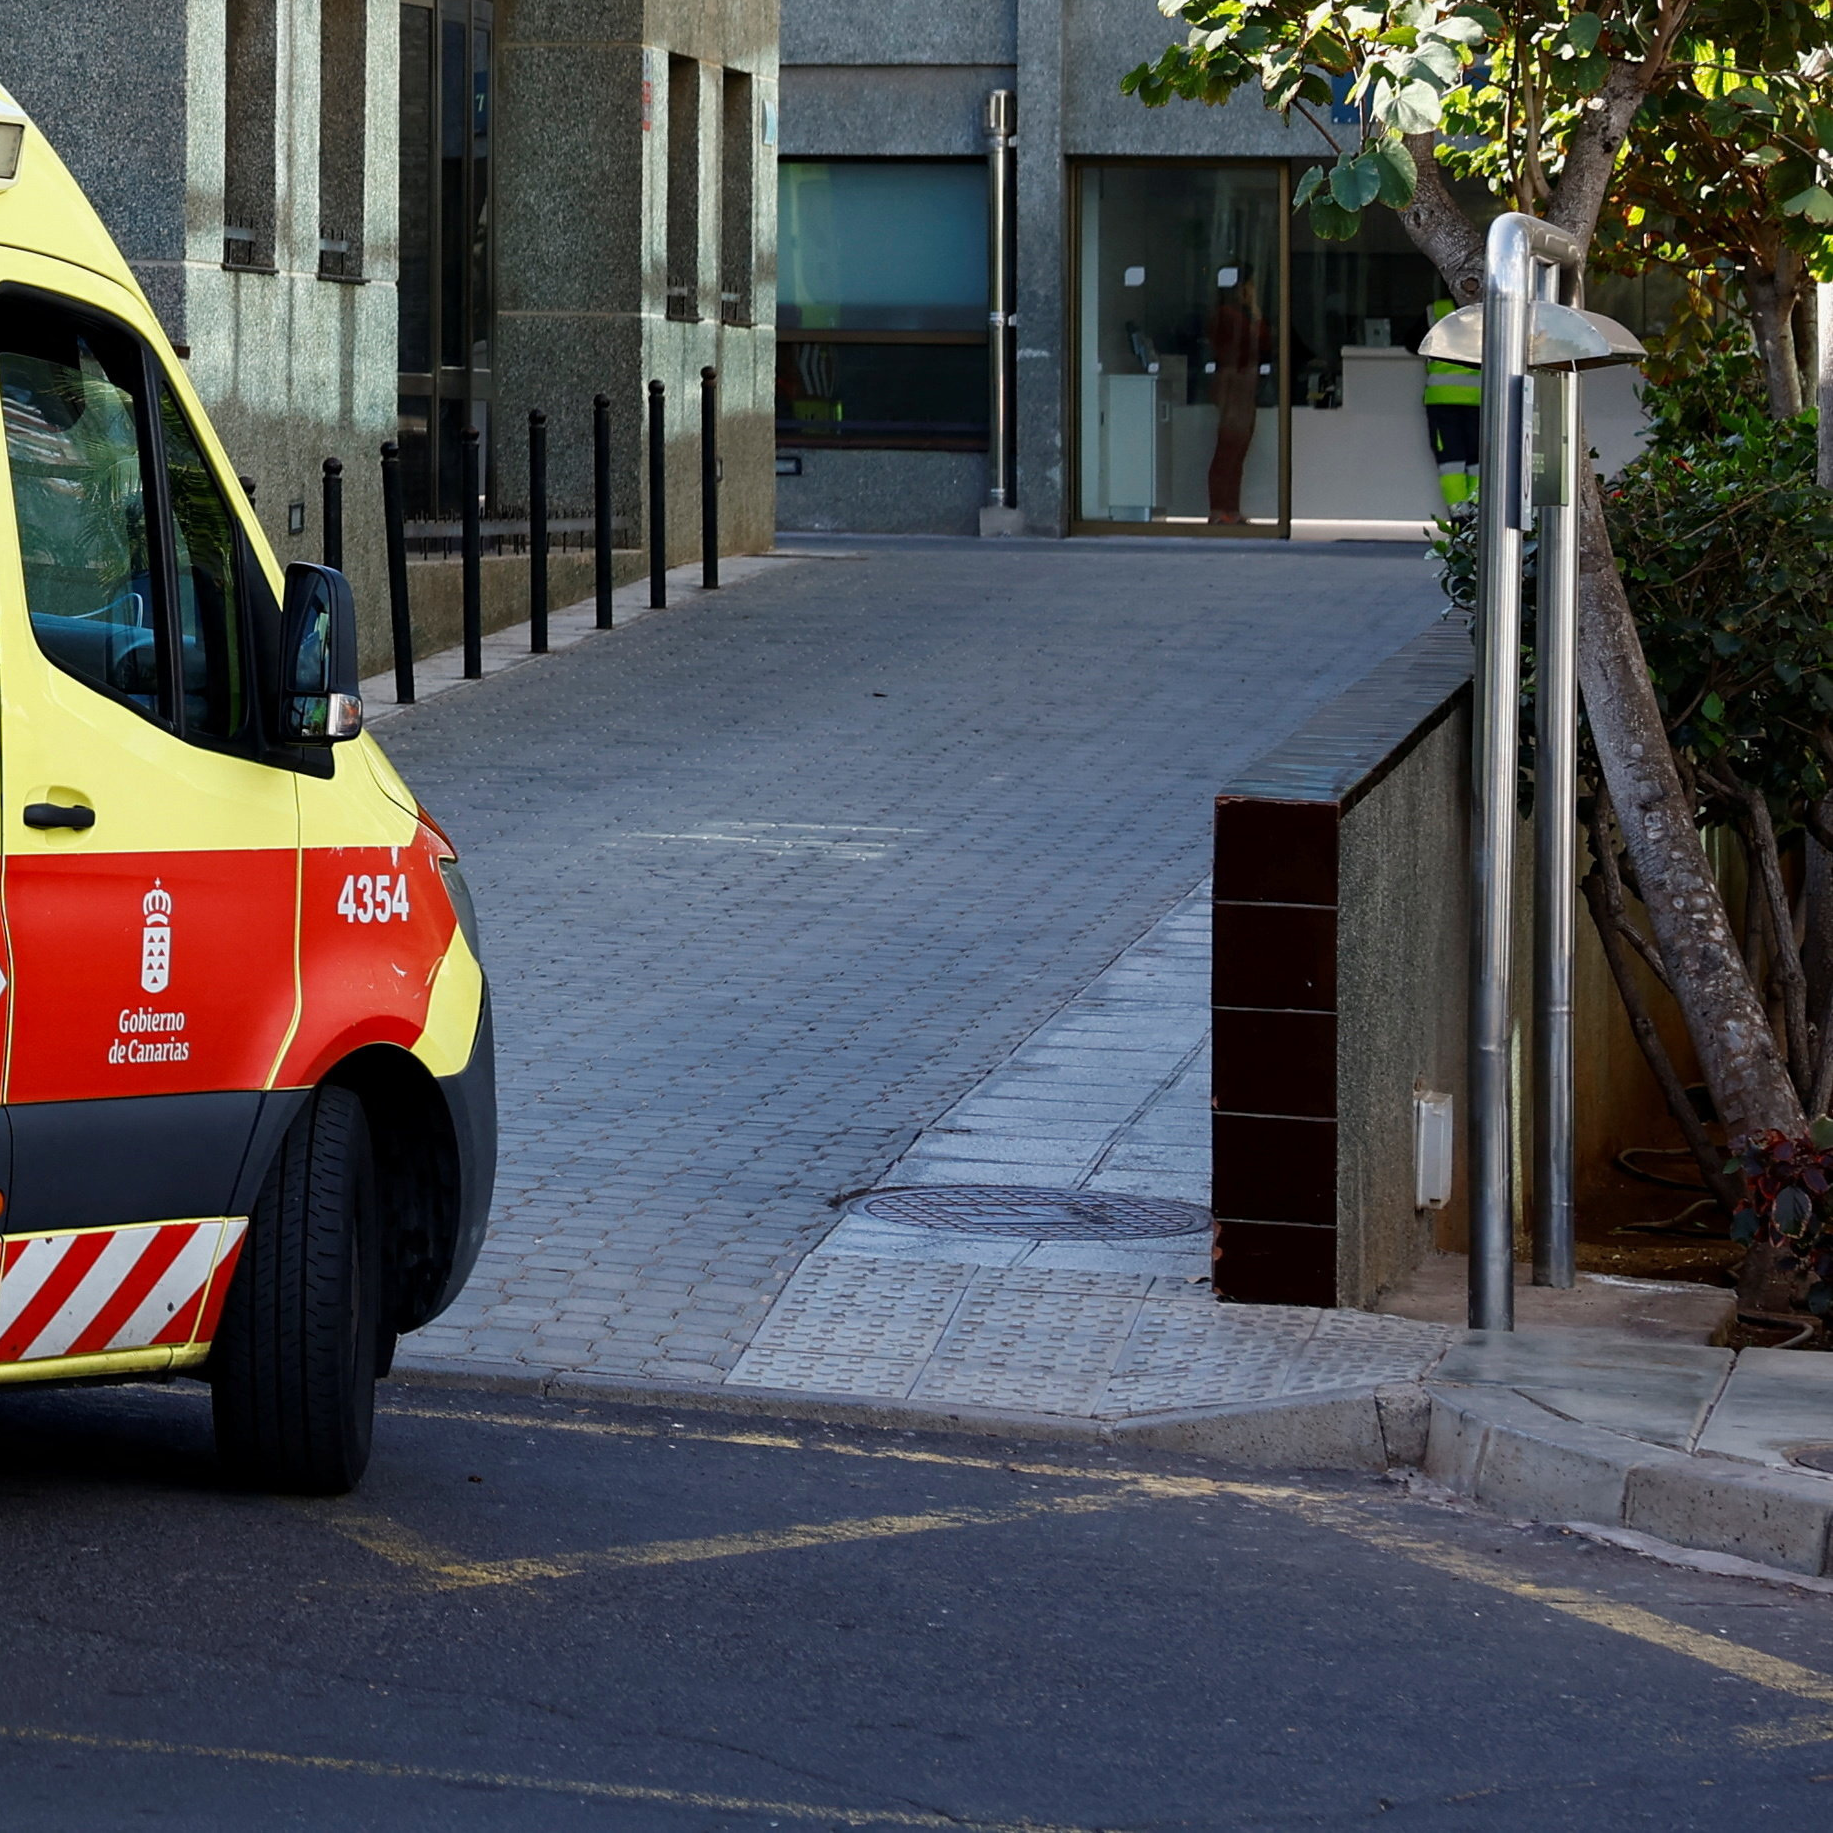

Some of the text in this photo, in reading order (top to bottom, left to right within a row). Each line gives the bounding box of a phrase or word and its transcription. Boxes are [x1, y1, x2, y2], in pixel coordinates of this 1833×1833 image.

[336, 873, 410, 924] 4354
[118, 1006, 185, 1033] Gobierno
[108, 1036, 189, 1065] de Canarias
